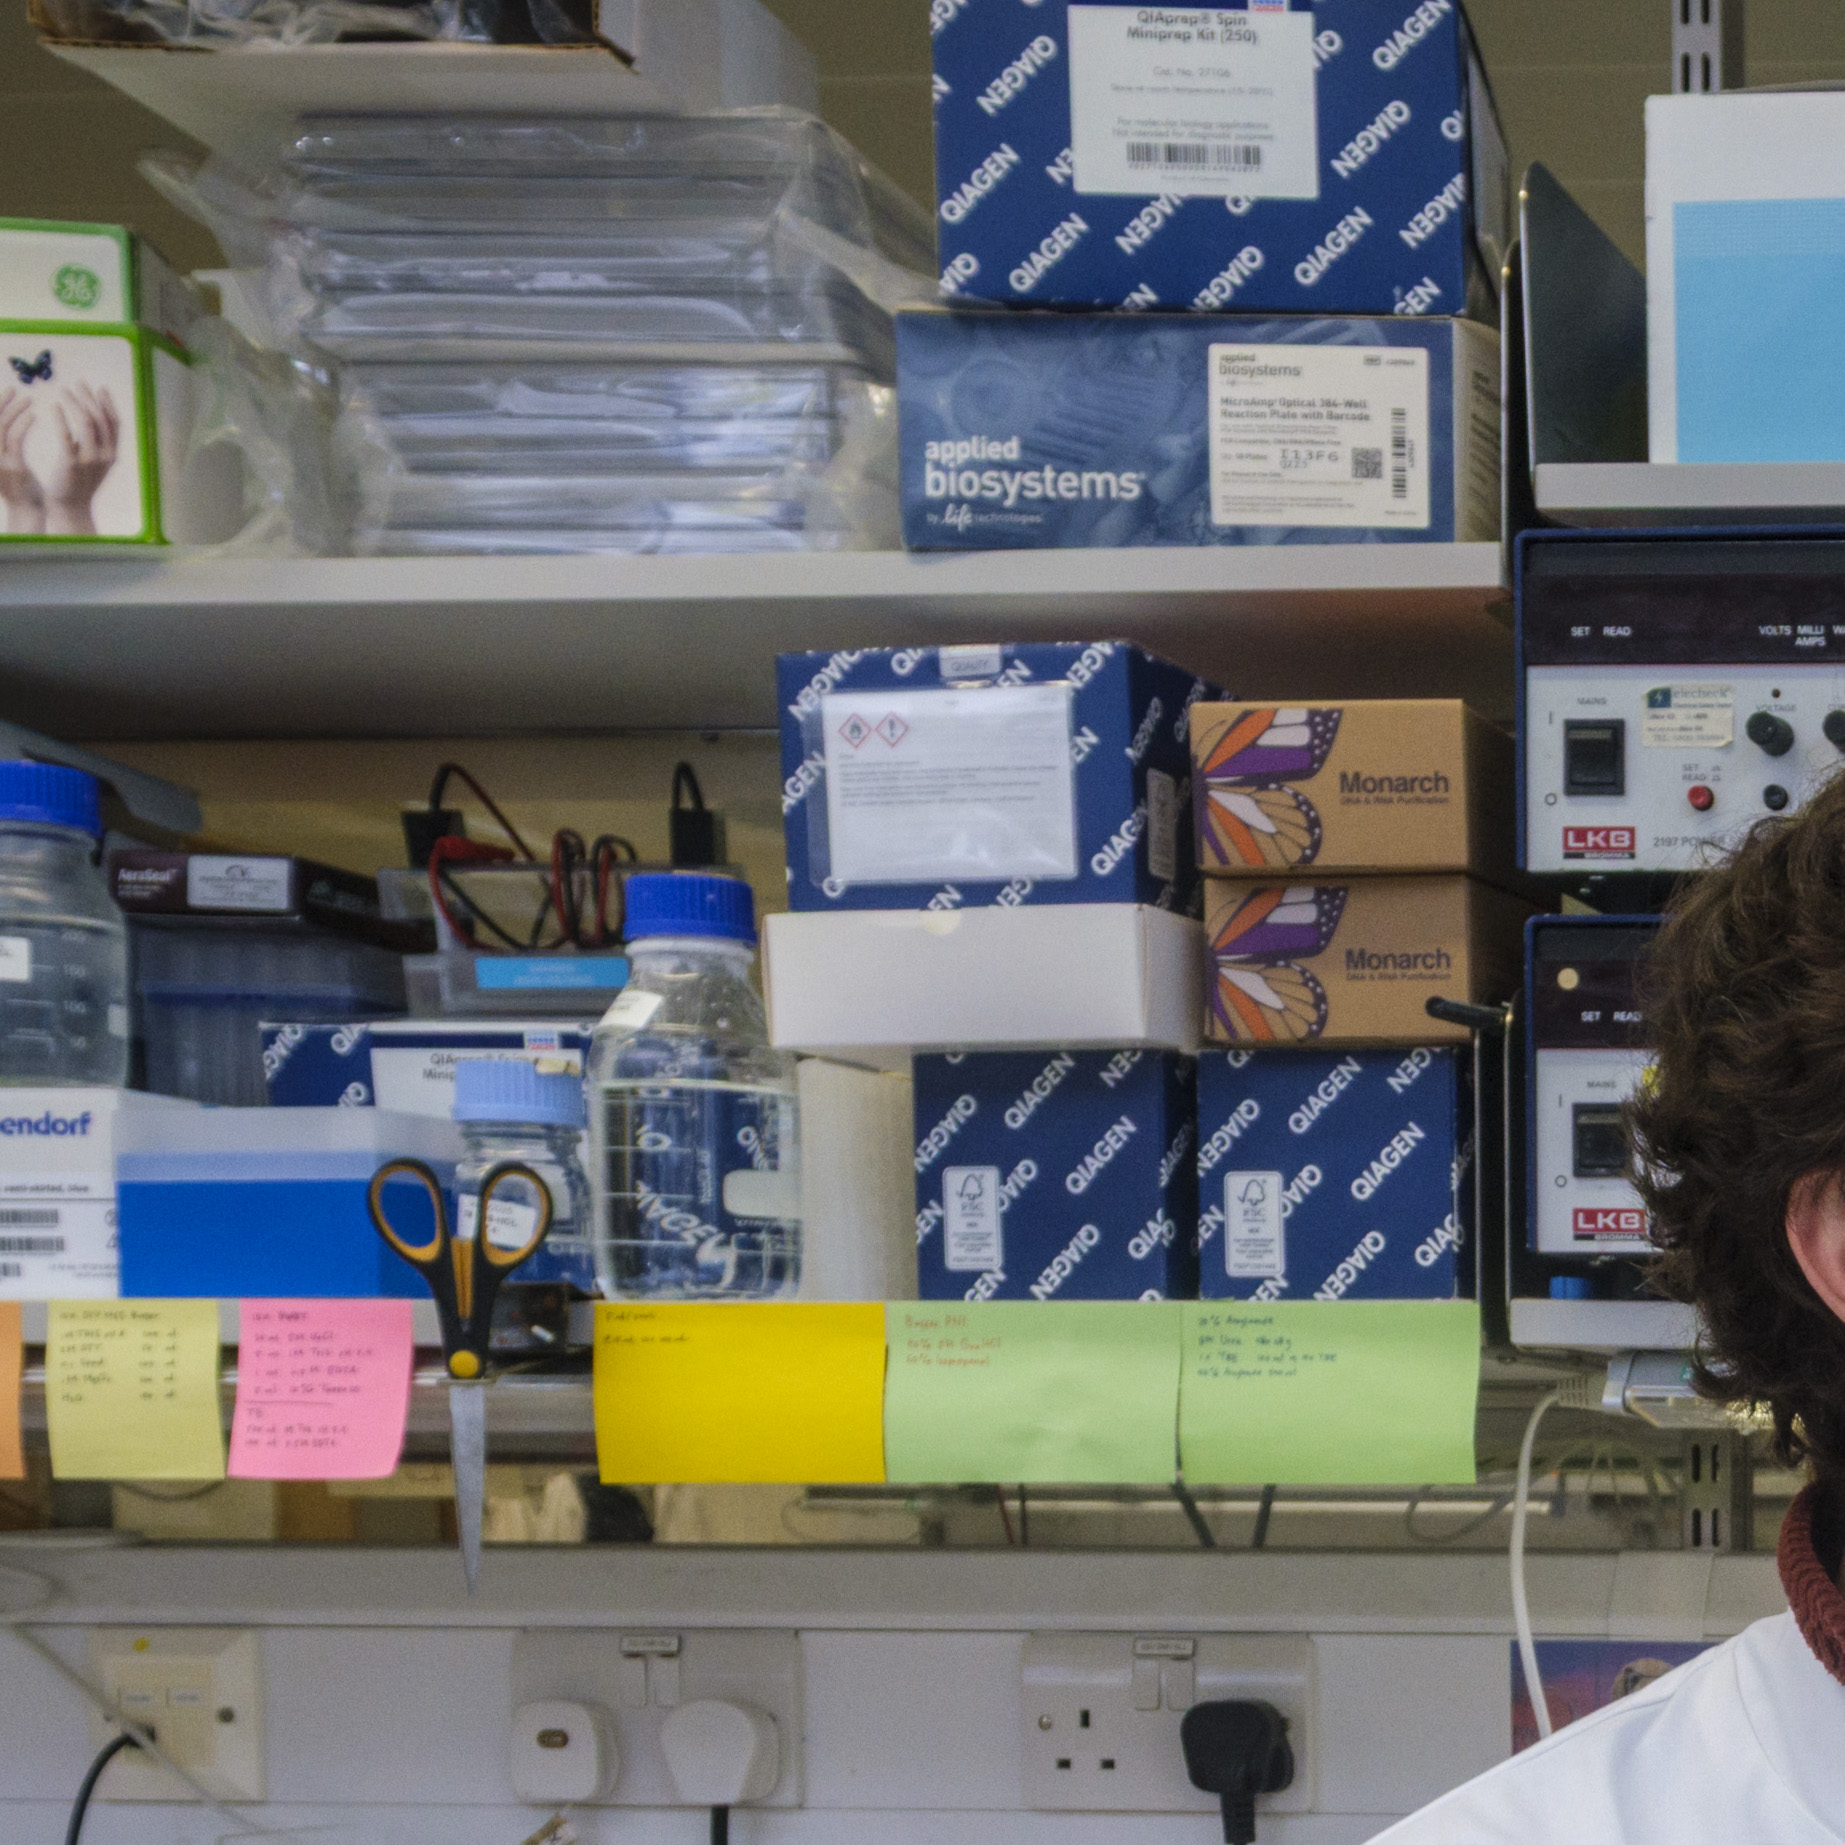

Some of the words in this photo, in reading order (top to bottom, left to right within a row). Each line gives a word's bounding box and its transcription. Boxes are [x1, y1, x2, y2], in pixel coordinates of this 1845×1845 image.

[1216, 12, 1247, 26] Spin
[1127, 26, 1192, 42] Miniprep
[1197, 27, 1215, 41] Kit
[1221, 29, 1257, 44] (250)
[1373, 0, 1452, 70] QIAGEN
[976, 36, 1057, 116] QIAGEN
[1331, 100, 1410, 178] QIAGEN
[940, 143, 1020, 222] QIAGEN
[1009, 213, 1089, 292] QIAGEN
[1295, 206, 1373, 286] QIAGEN
[1394, 277, 1441, 315] GEN
[925, 435, 1020, 467] applied
[926, 513, 939, 524] by
[1571, 627, 1590, 637] SET
[1603, 626, 1632, 637] READ
[1759, 625, 1792, 635] VOLTS
[1795, 636, 1826, 646] AMPS
[1797, 625, 1825, 635] MILLI
[1756, 704, 1796, 712] VOLTAGE
[1682, 764, 1699, 772] SET
[1682, 774, 1707, 782] READ
[1340, 771, 1450, 793] Monarch
[1567, 829, 1632, 848] LKB
[1653, 836, 1679, 847] 2197
[1345, 948, 1451, 971] Monarch
[1581, 1011, 1601, 1022] SET
[1613, 1011, 1641, 1022] READ
[1387, 1048, 1432, 1094] GEN
[1004, 1052, 1075, 1130] QIAGEN
[1289, 1055, 1362, 1134] QIAGEN
[0, 1112, 91, 1136] endorf
[1066, 1115, 1137, 1195] QIAGEN
[1351, 1121, 1426, 1201] QIAGEN
[1577, 1212, 1640, 1229] LKB
[1030, 1223, 1100, 1300] QIAGEN
